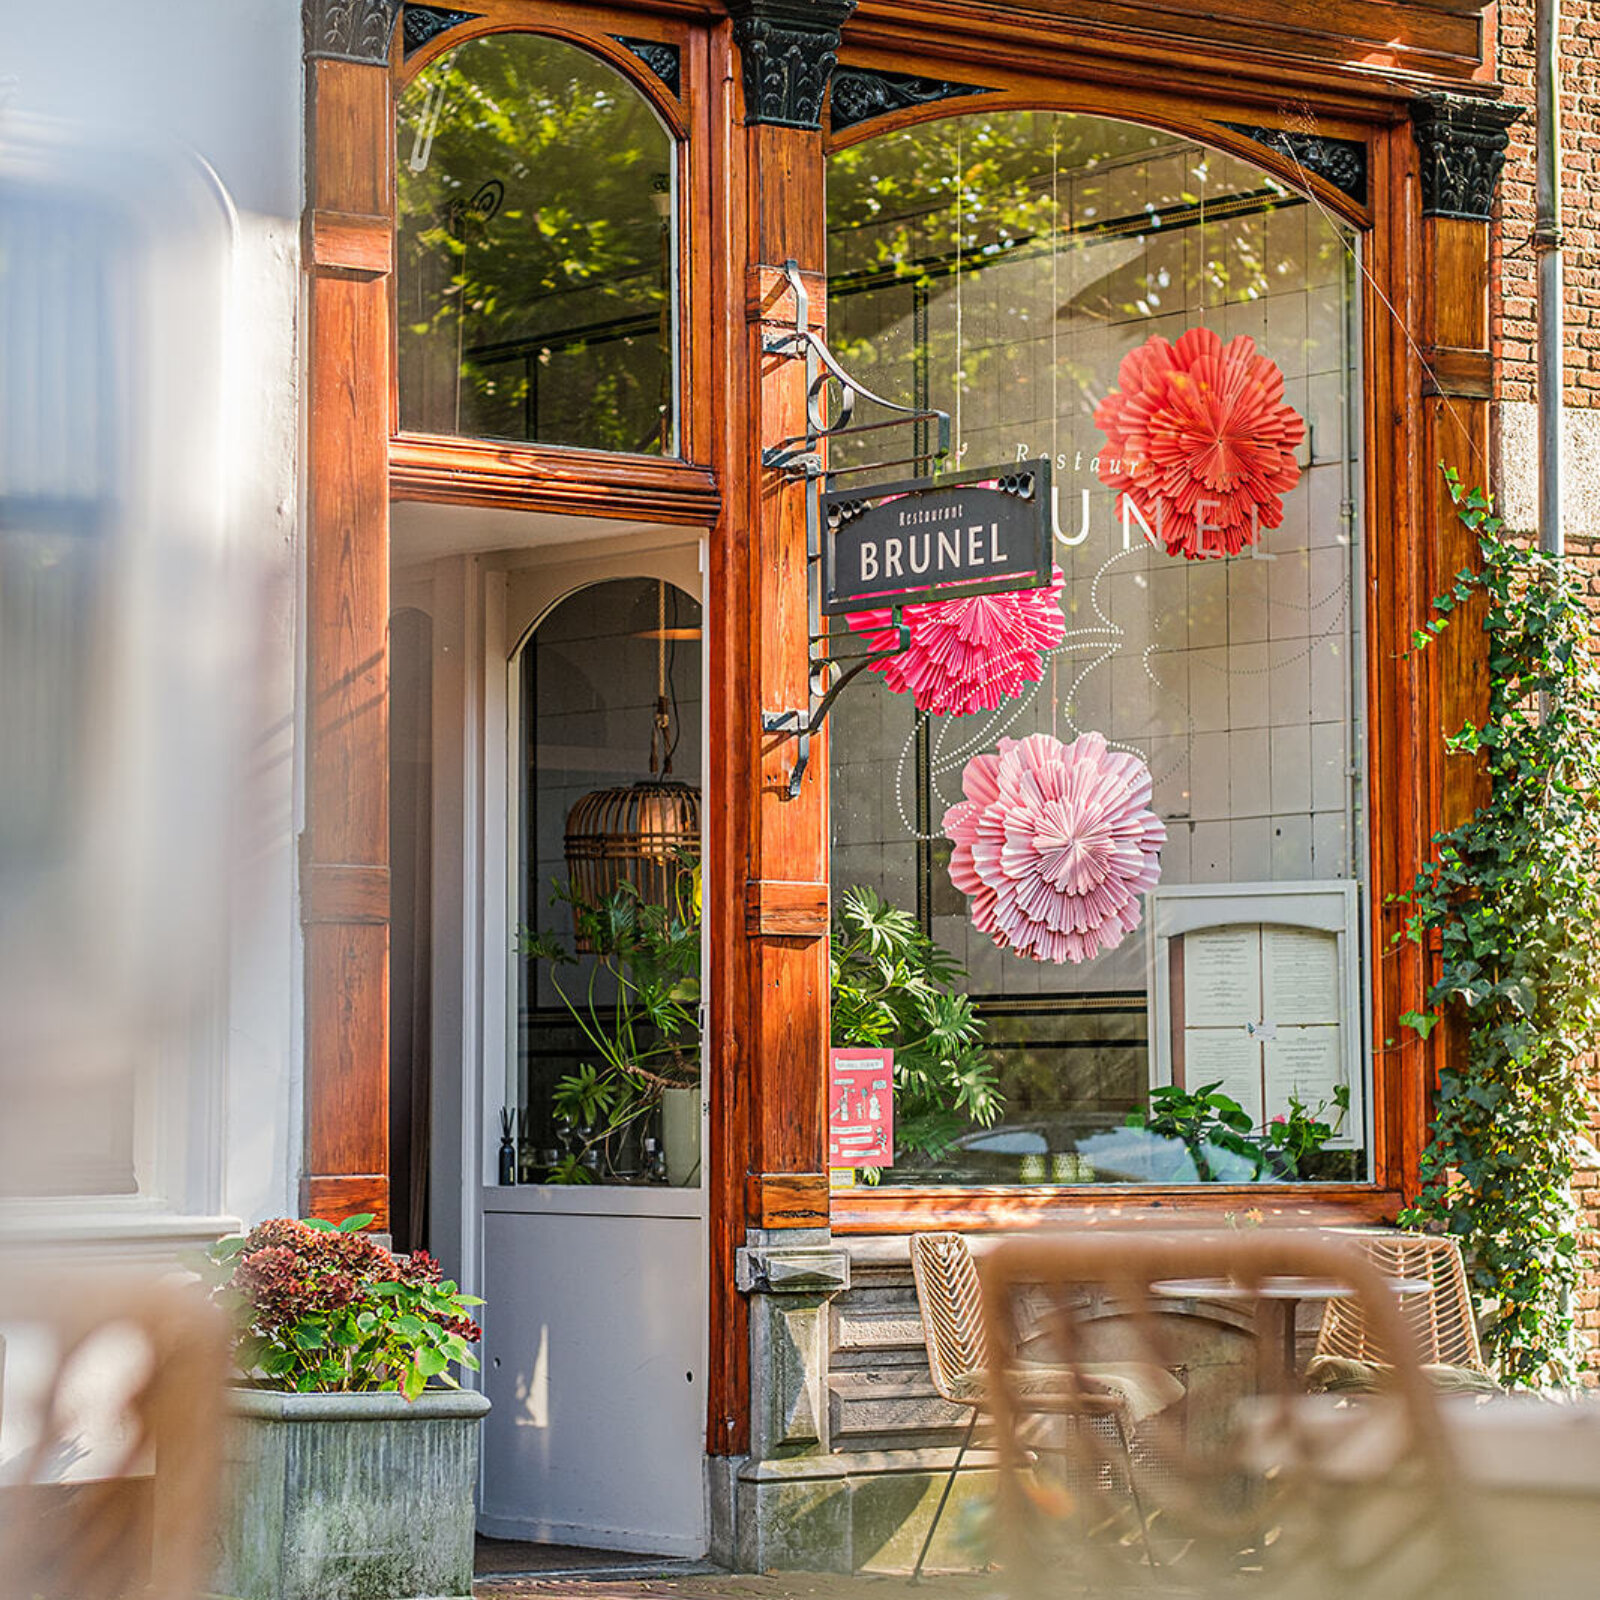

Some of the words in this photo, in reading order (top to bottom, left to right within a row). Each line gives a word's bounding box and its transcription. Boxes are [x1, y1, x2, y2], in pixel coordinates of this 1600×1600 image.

[899, 503, 964, 527] Restaurant
[1051, 485, 1278, 562] UNEL
[860, 522, 1008, 582] BRUNEL
